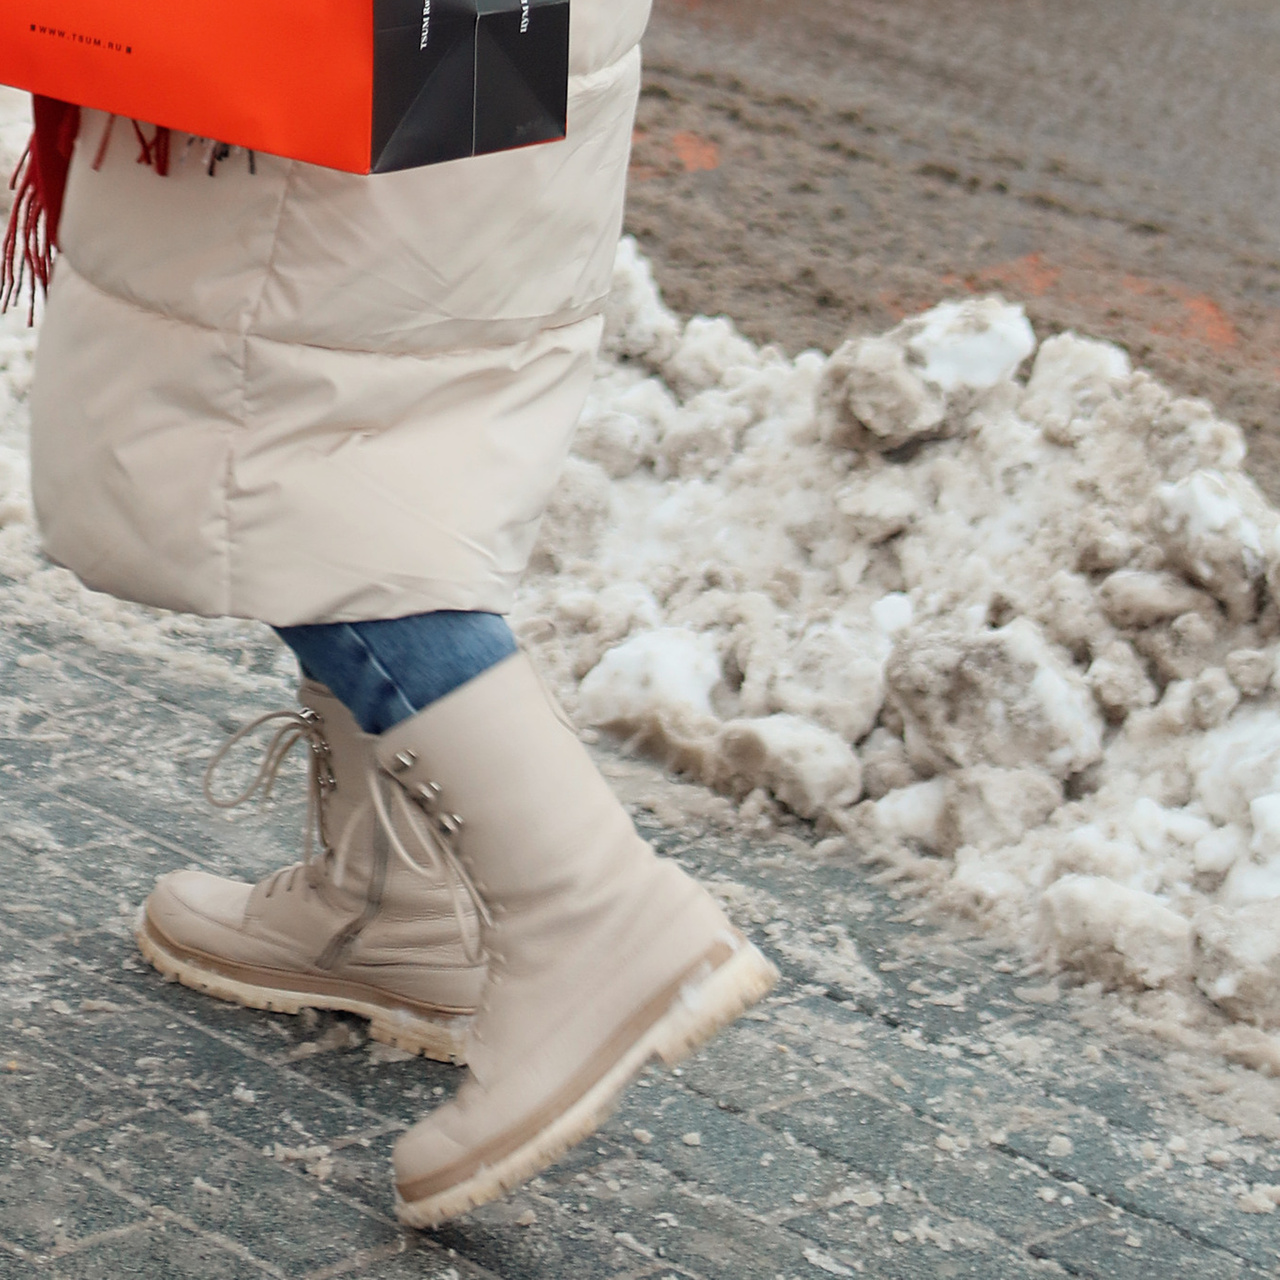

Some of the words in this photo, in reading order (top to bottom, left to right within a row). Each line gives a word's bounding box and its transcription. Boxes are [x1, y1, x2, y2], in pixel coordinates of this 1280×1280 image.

[419, 16, 430, 50] TSUM
[519, 4, 530, 33] ЦУМ
[38, 24, 123, 52] WWW.TSUM.RU
